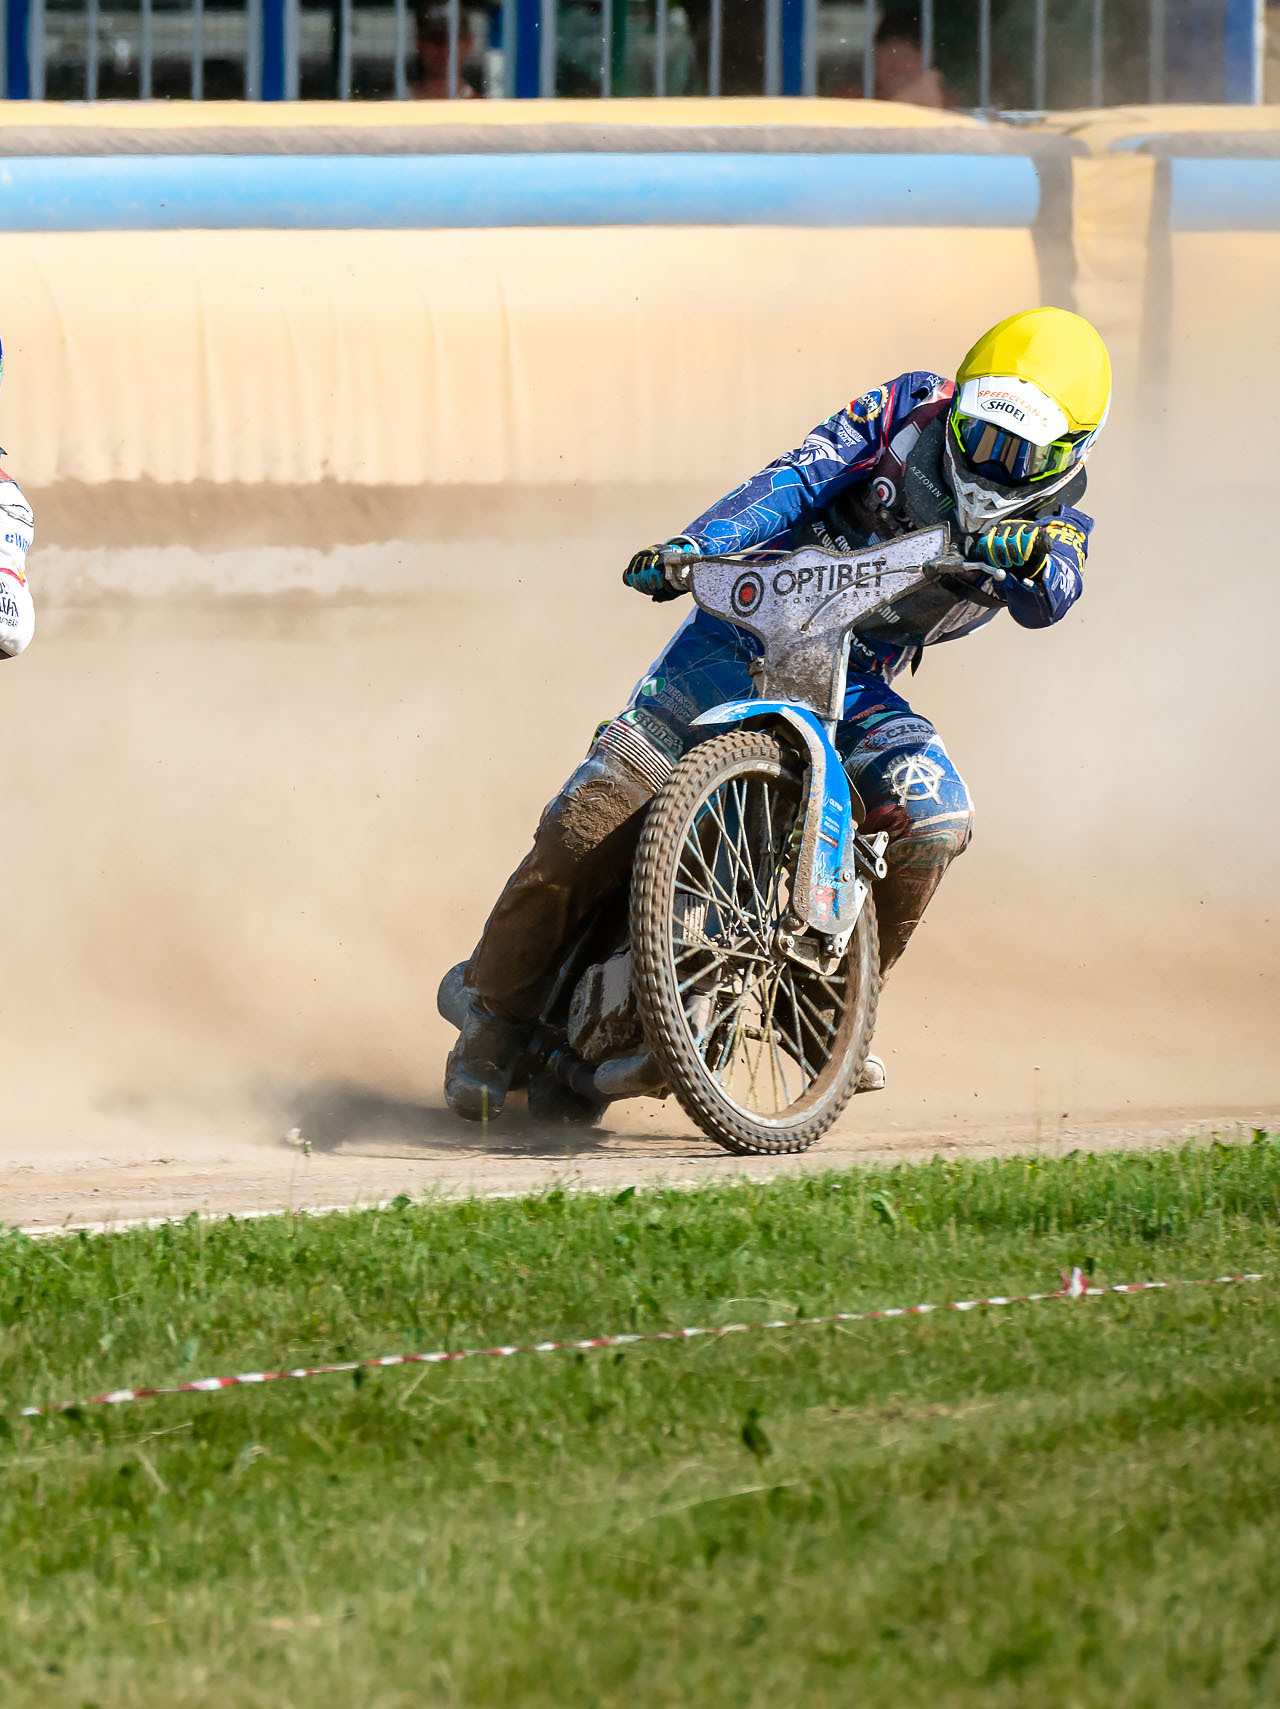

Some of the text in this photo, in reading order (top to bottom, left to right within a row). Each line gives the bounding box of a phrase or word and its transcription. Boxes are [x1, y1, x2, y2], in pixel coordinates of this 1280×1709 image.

[987, 401, 1026, 422] SHOEI
[910, 465, 943, 498] AZTORIN
[772, 560, 887, 596] OPTIBET
